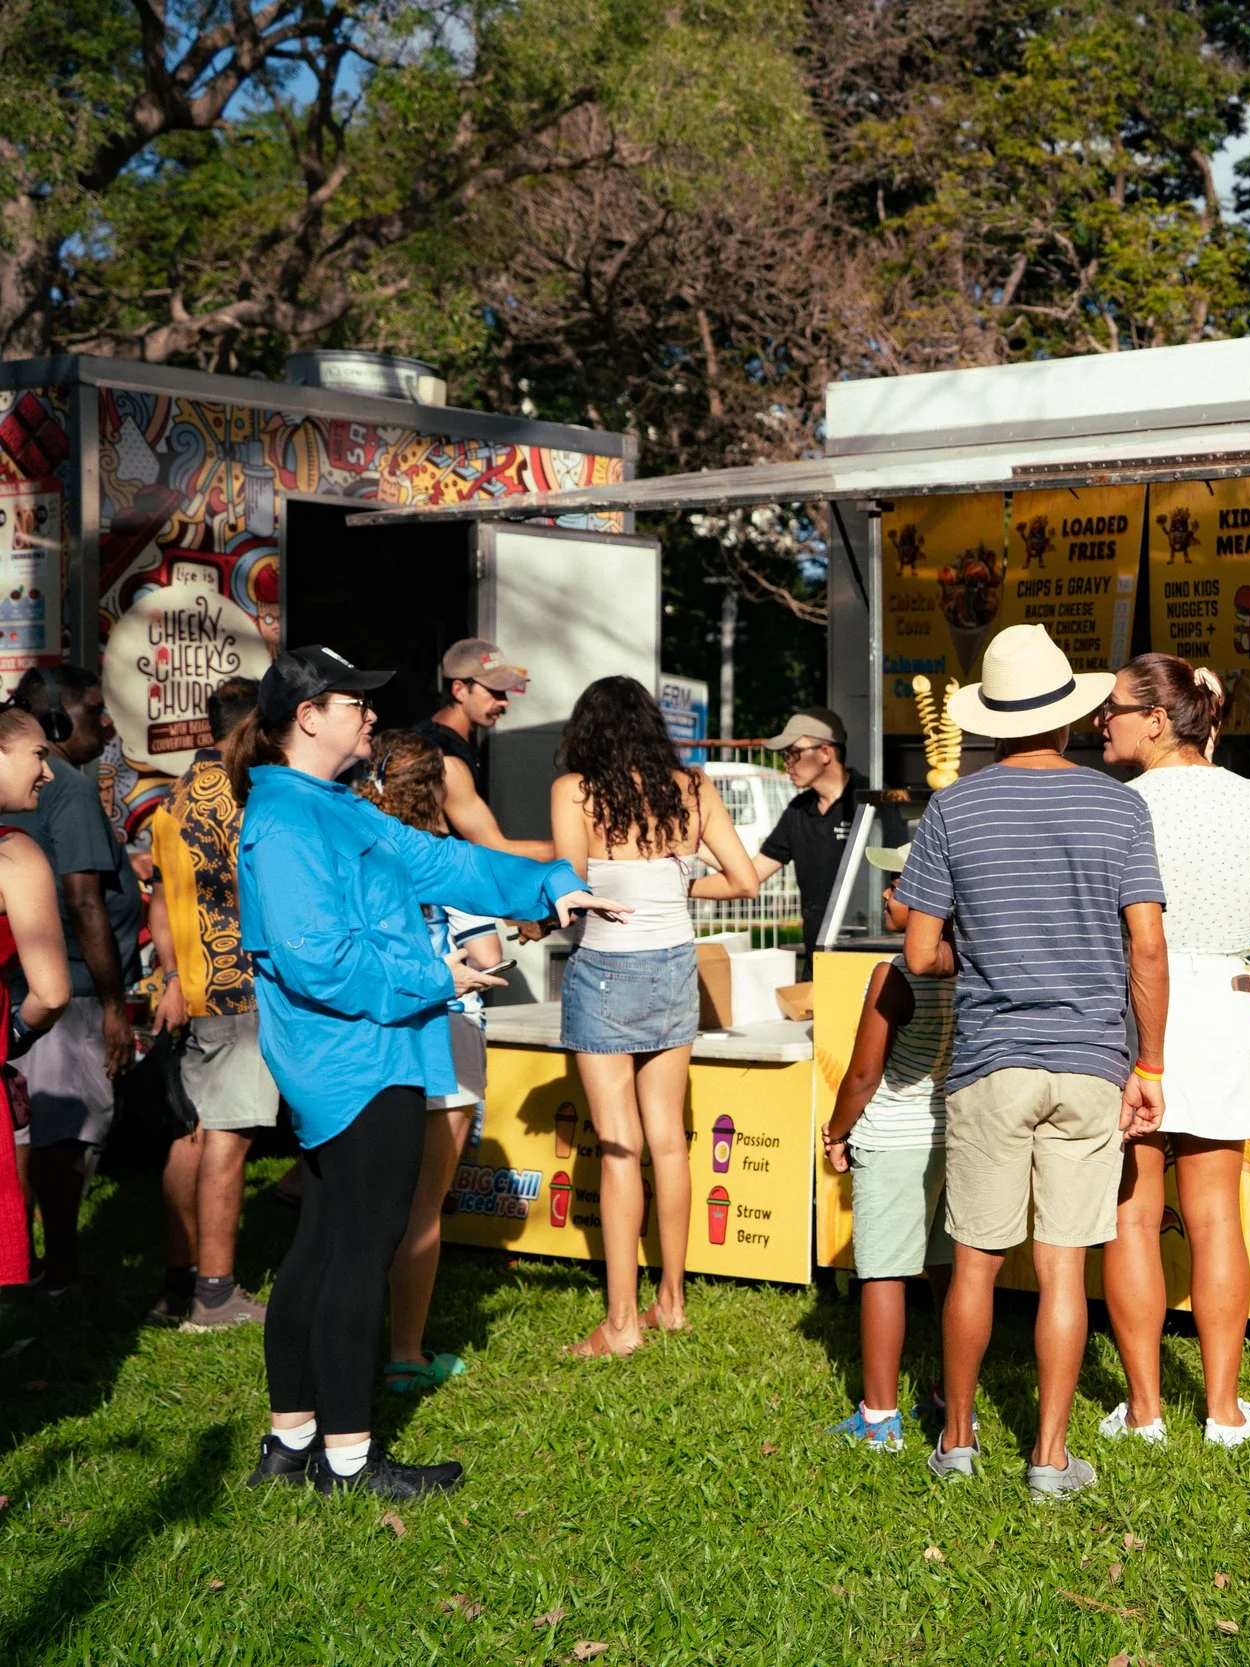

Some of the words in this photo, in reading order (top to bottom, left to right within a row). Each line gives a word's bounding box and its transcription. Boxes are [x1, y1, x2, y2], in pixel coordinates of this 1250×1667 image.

[1062, 515, 1128, 537] LOADED
[1068, 540, 1116, 562] FRIES
[1017, 579, 1051, 598] CHIPS
[1055, 578, 1063, 596] &
[1067, 576, 1111, 595] GRAVY
[1164, 581, 1190, 598] DINO
[1193, 580, 1220, 597] KIDS
[1024, 603, 1056, 619] BACON
[1059, 602, 1095, 617] CHEESE
[1166, 600, 1219, 618] NUGGETS
[148, 597, 223, 645] CHEEKY
[1055, 620, 1096, 634] CHICKEN
[1170, 622, 1203, 639] CHIPS
[1206, 623, 1217, 635] +
[1073, 638, 1101, 652] CHIPS
[1176, 641, 1211, 658] DRINK
[153, 636, 240, 682] CHEEKY
[1086, 657, 1109, 670] MEAL
[736, 1132, 780, 1148] Passion
[743, 1156, 769, 1172] fruit
[456, 1165, 494, 1193] BIG
[494, 1168, 542, 1200] Chill
[458, 1191, 496, 1215] Iced
[496, 1194, 529, 1219] Tea
[575, 1189, 601, 1204] Wat
[737, 1204, 772, 1220] Straw
[573, 1214, 601, 1228] melo
[737, 1229, 770, 1249] Berry
